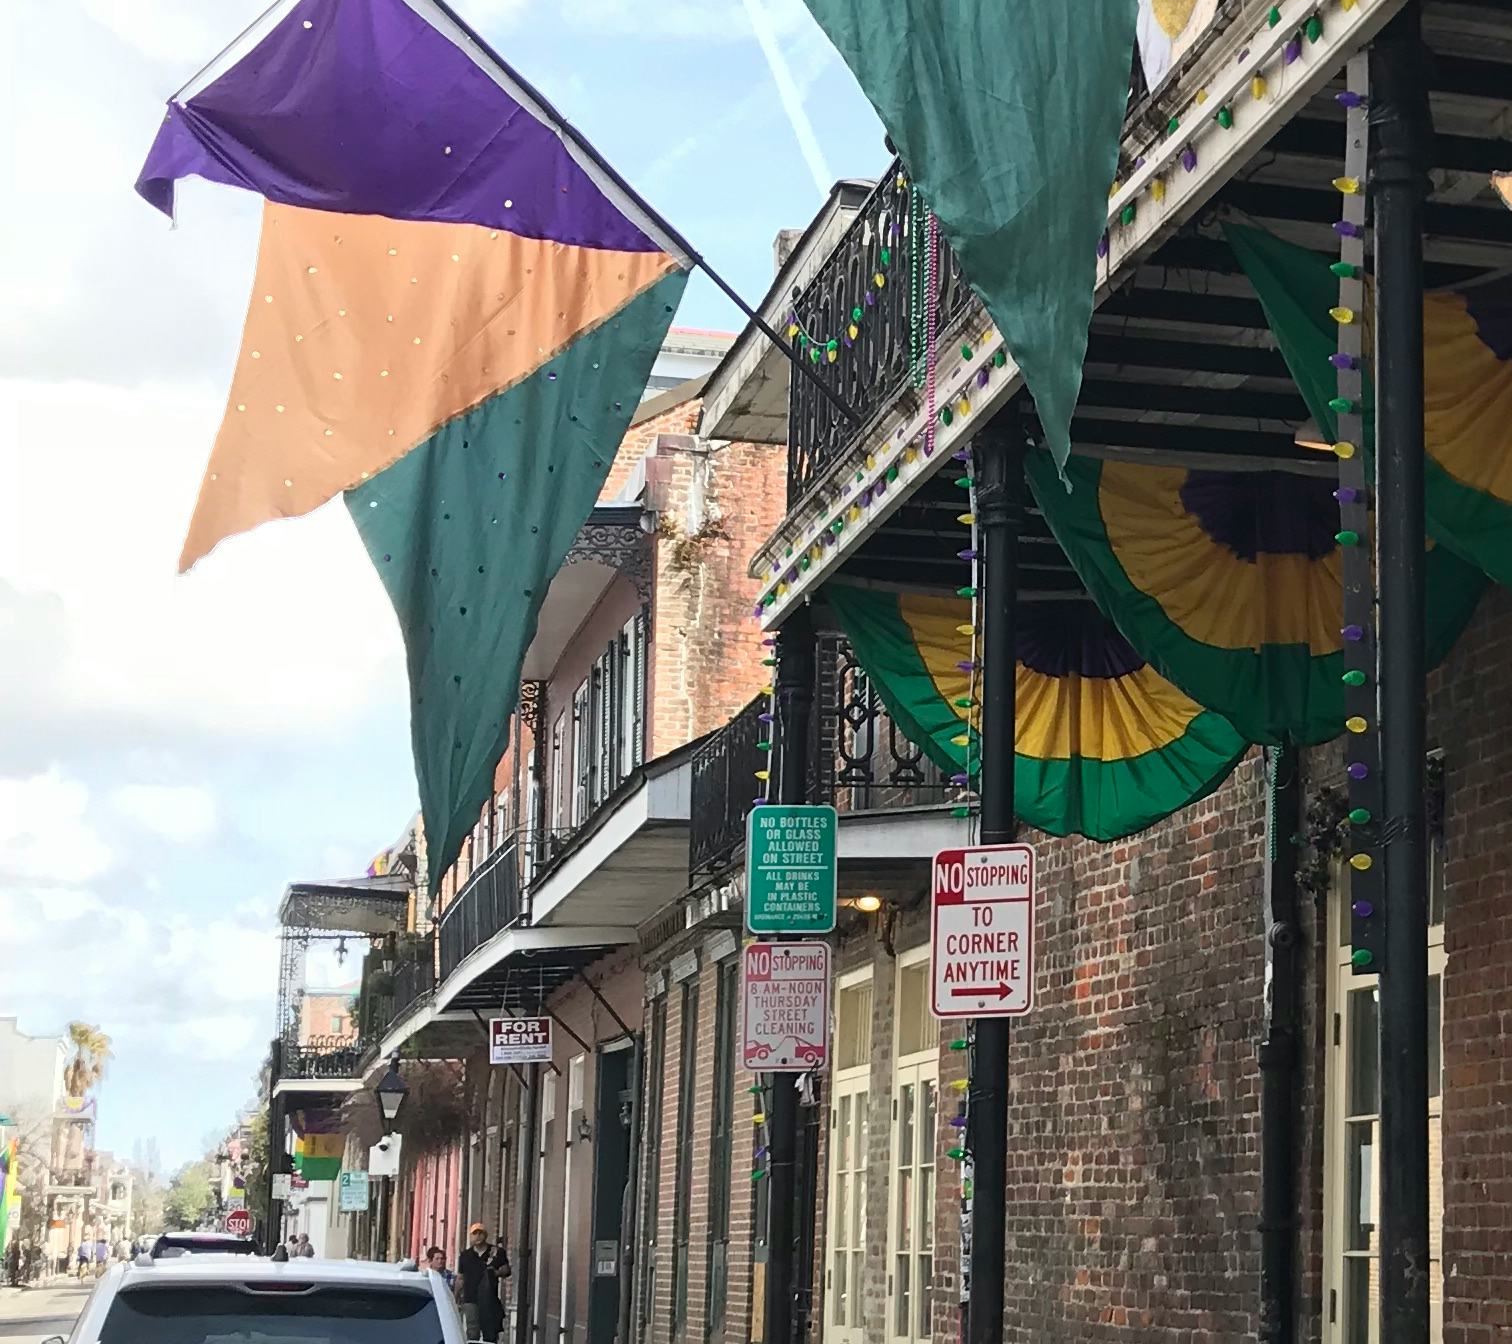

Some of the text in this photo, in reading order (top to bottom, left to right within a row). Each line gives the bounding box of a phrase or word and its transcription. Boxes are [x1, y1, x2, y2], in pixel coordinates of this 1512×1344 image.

[760, 817, 828, 828] NO BOTTLES
[766, 829, 821, 840] OR GLASS
[768, 841, 819, 852] ALLOWED
[762, 853, 823, 864] ON STREET
[766, 872, 820, 881] ALL DRINKS
[936, 862, 1028, 894] NO STOPPING
[775, 882, 809, 891] MAY BE
[767, 892, 818, 901] IN PLASTIC
[764, 902, 821, 912] CONTAINERS
[972, 906, 993, 927] TO
[946, 932, 1019, 955] CORNER
[747, 951, 823, 976] NO STOPPING
[943, 959, 1021, 983] ANYTIME
[751, 982, 758, 995] 8
[753, 996, 818, 1008] THURSDAY
[763, 1009, 808, 1021] STREET
[501, 1021, 540, 1033] FOR
[755, 1022, 815, 1035] CLEANING
[495, 1032, 547, 1045] RENT
